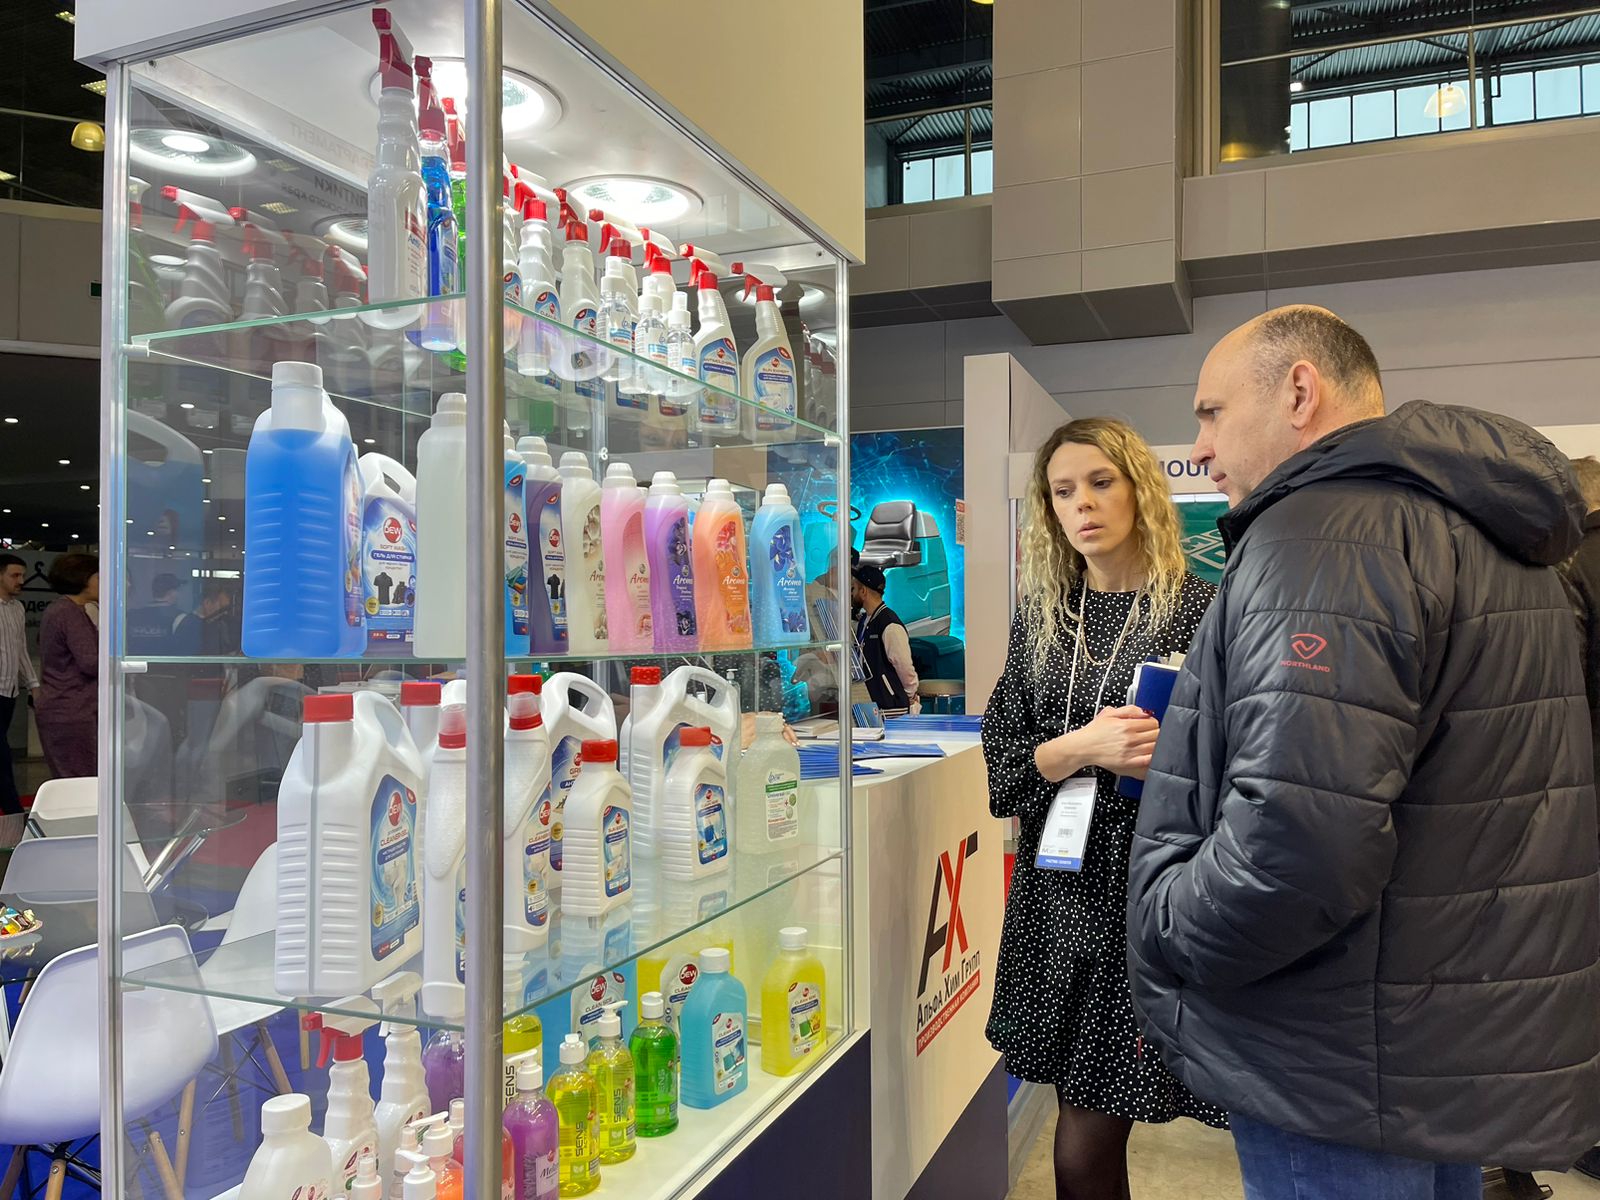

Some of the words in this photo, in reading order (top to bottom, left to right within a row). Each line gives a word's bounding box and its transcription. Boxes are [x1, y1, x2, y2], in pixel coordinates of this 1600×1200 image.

[384, 526, 402, 535] DEW
[673, 574, 693, 585] Arom
[777, 577, 801, 586] Aroma
[1280, 660, 1330, 673] NORTHLAND
[388, 803, 402, 817] DEW
[681, 970, 697, 979] DEW
[591, 983, 607, 994] DEW
[614, 1089, 622, 1123] SENS
[575, 1121, 584, 1157] SENS
